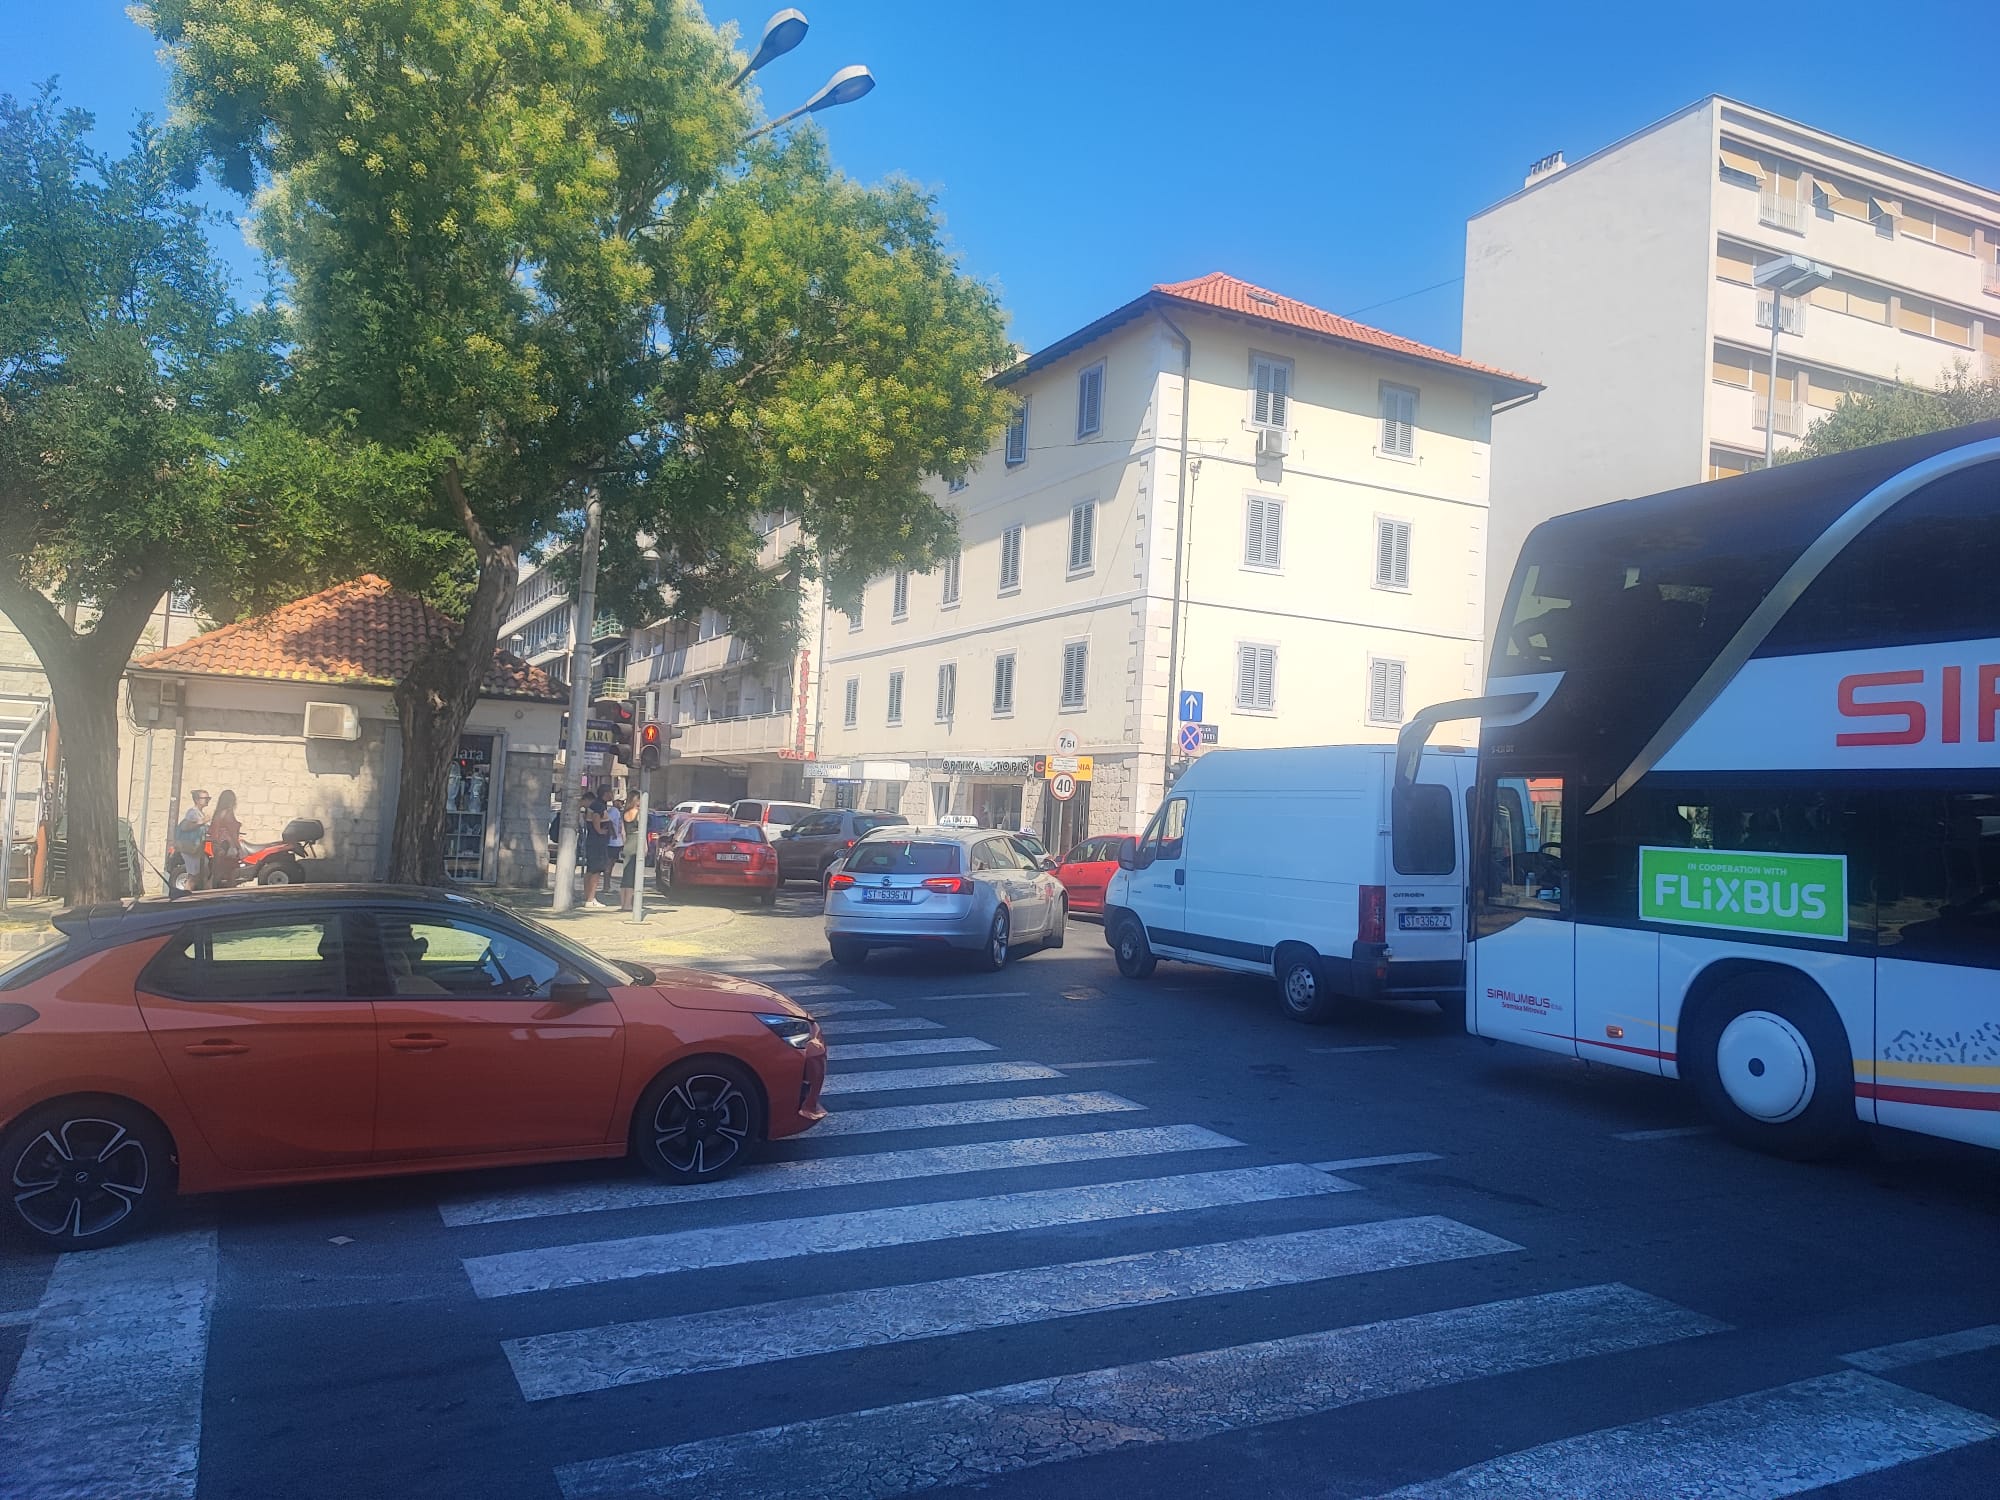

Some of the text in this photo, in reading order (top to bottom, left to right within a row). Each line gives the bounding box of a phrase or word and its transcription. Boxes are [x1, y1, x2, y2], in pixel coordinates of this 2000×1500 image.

[1836, 664, 2000, 747] SI
[942, 760, 981, 771] OPTIKA
[1056, 779, 1071, 793] 40
[1687, 863, 1788, 876] IN COOPERATION WITH
[1487, 988, 1551, 1009] SIRMIUMBUS
